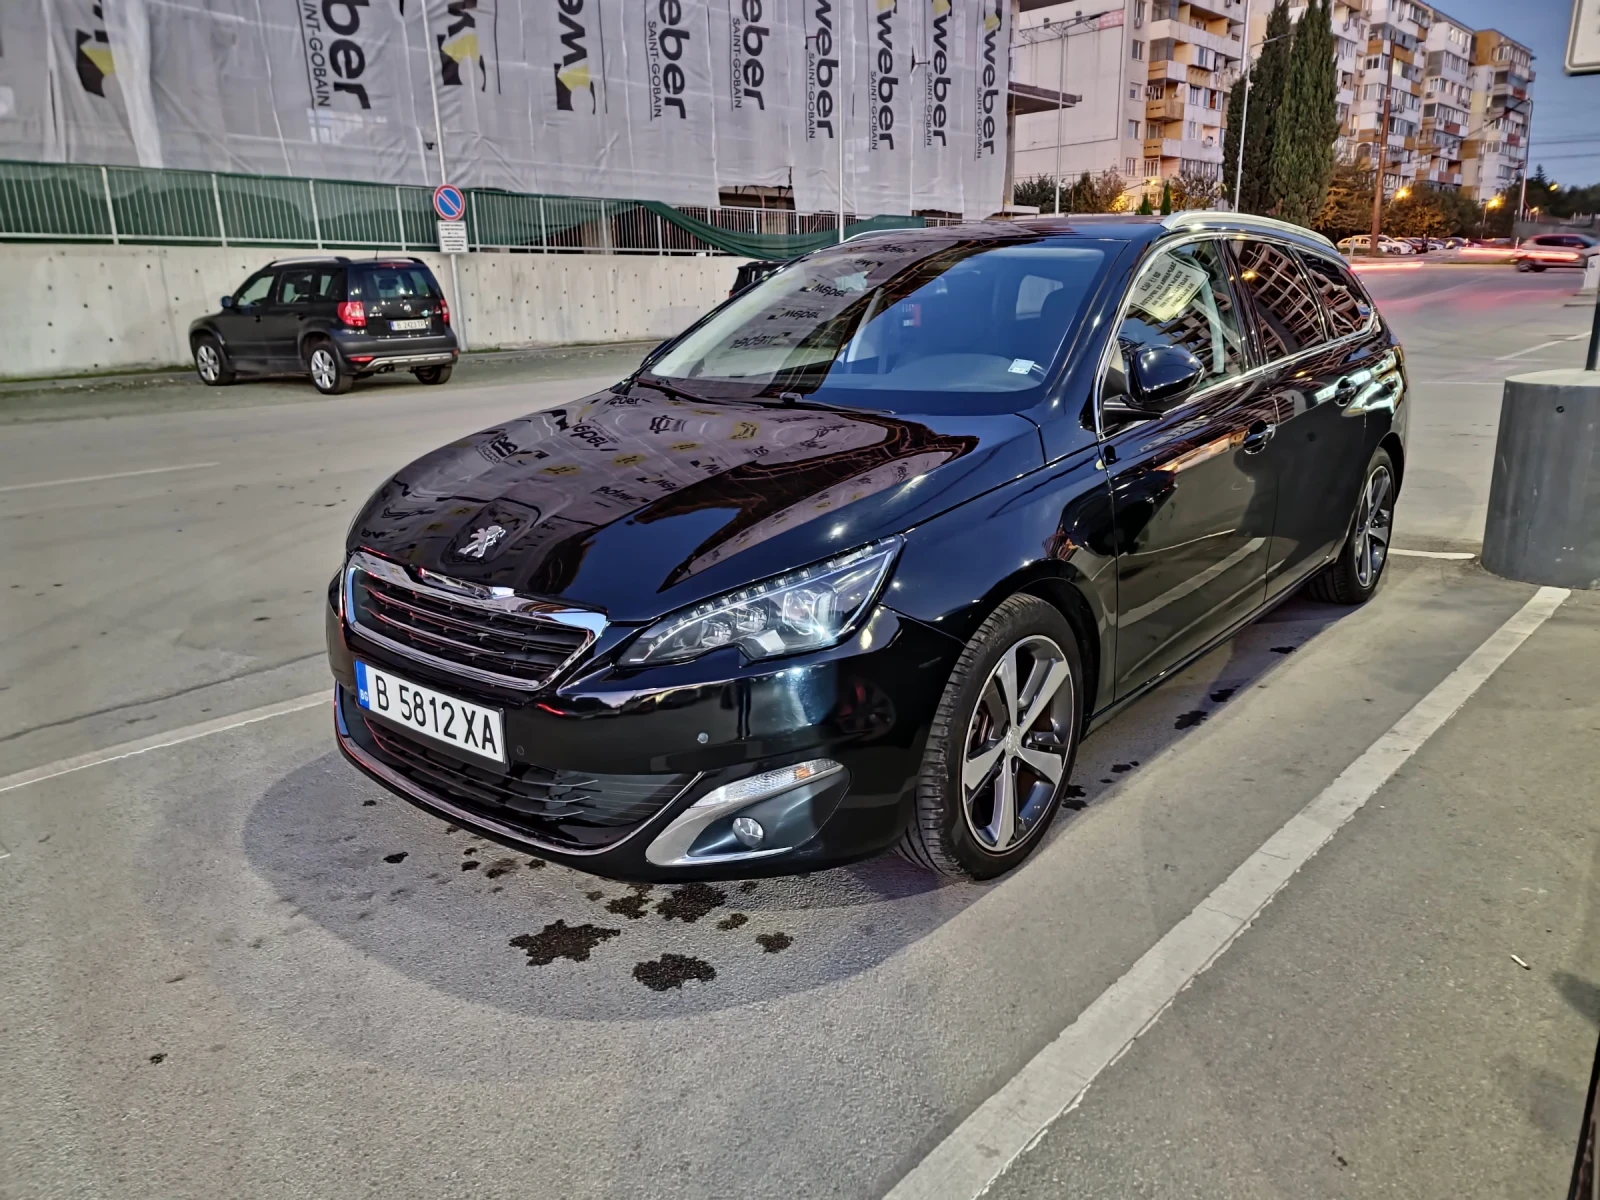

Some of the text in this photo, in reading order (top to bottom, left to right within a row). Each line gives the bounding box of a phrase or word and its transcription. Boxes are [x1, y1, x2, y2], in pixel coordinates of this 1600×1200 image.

[648, 21, 663, 118] SAINT-GOBAIN
[658, 0, 690, 119] eber
[732, 17, 742, 109] SAINT-GOBAIN
[742, 0, 769, 110] eber
[808, 52, 816, 139] SAINT-GOBAIN
[815, 0, 839, 138] weber
[877, 10, 899, 150] weber
[933, 14, 951, 146] weber
[983, 30, 999, 155] weber
[870, 71, 879, 150] SAINT-GOBAIN
[359, 688, 370, 701] BG
[375, 674, 497, 754] B 5812 XA
